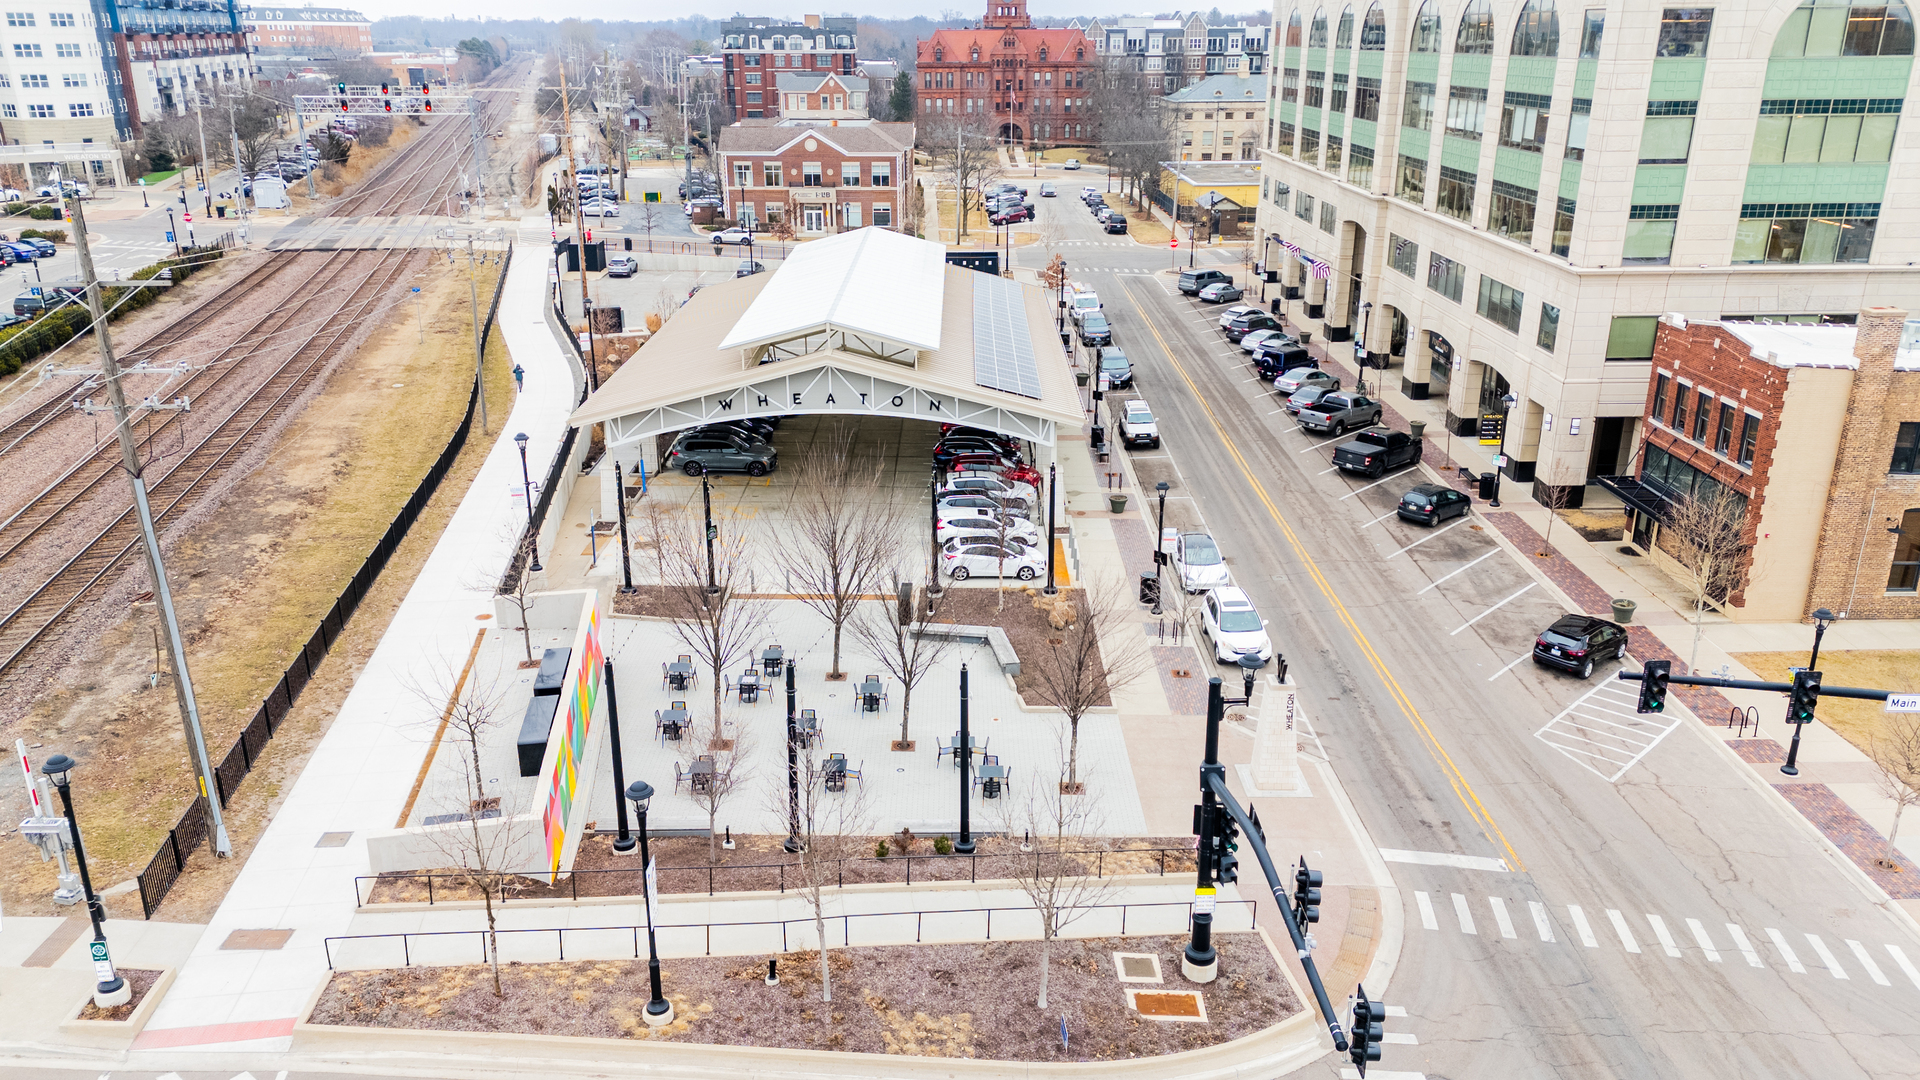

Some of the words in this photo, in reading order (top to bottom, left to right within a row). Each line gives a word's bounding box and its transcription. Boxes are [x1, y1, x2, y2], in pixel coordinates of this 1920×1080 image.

[717, 391, 942, 413] WHEATON
[1286, 694, 1295, 731] WHEATON
[1891, 699, 1916, 708] Main
